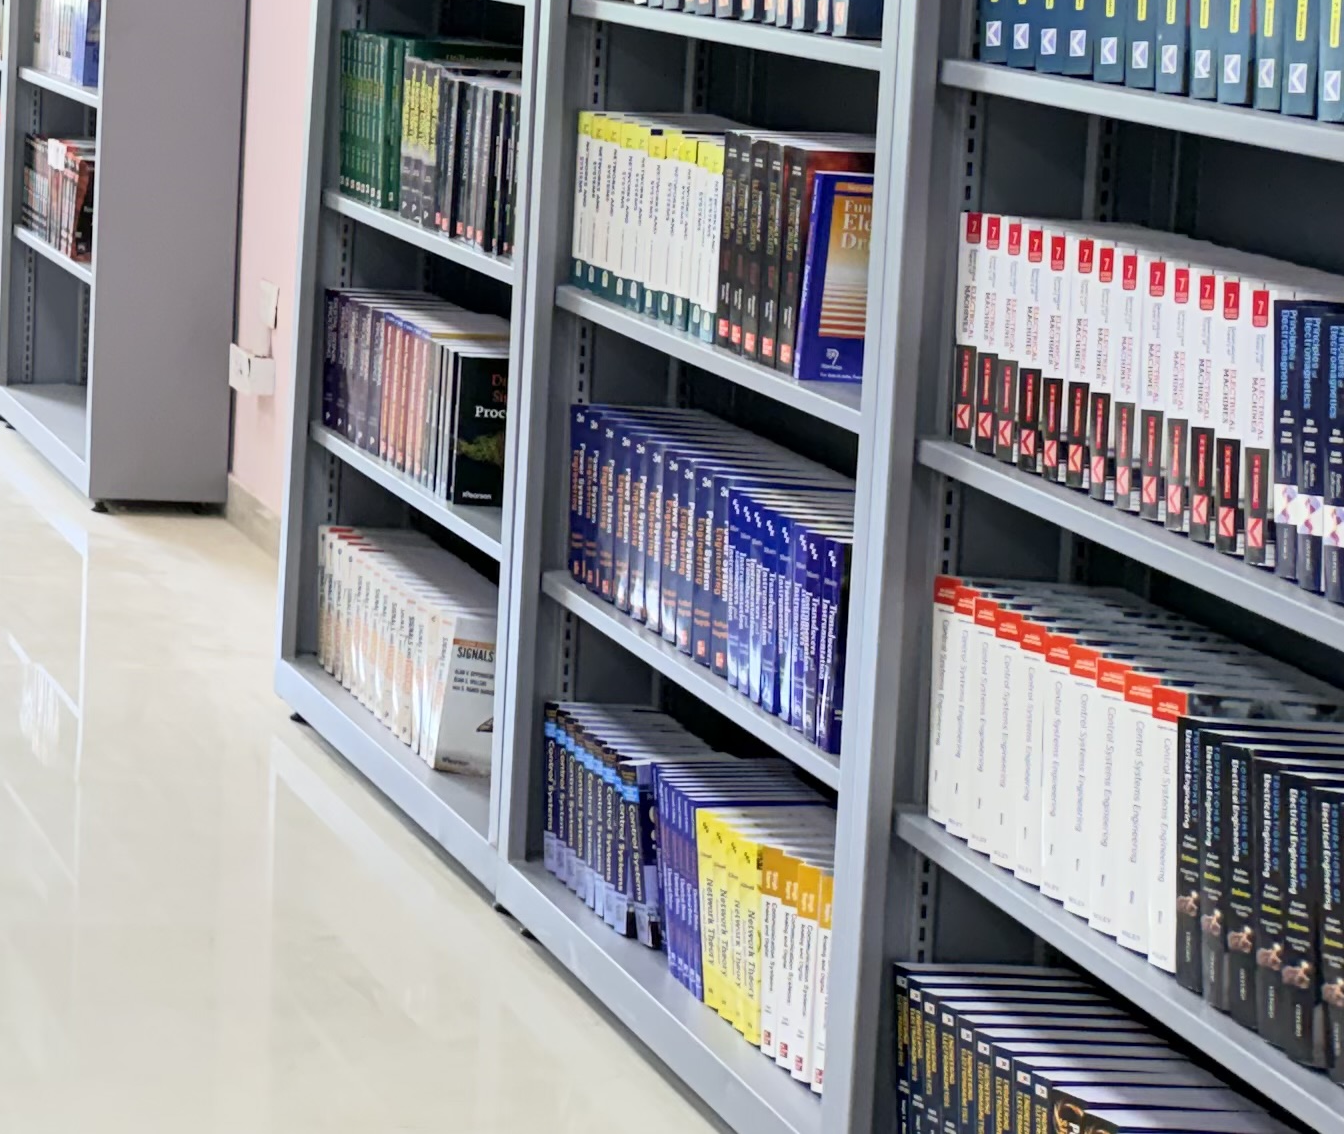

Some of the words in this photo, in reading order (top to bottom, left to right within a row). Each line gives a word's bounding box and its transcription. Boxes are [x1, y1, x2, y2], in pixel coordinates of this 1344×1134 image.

[1025, 306, 1033, 356] MACHINES
[1031, 306, 1040, 362] ELECTRICAL
[1074, 318, 1083, 369] MACHINES
[1079, 319, 1089, 377] ELECTRICAL
[1280, 310, 1289, 401] Electromagnetics
[1197, 359, 1205, 414] MACHINES
[1203, 359, 1212, 421] ELECTRICAL
[1304, 318, 1312, 410] Electromagnetics
[1329, 326, 1338, 419] Electromagnetics
[1221, 369, 1230, 424] MACHINES
[1227, 369, 1237, 432] ELECTRICAL
[1250, 377, 1259, 433] MACHINES
[1256, 378, 1266, 441] ELECTRICAL
[639, 476, 647, 510] Power
[638, 513, 646, 552] System
[678, 508, 687, 575] Engineering
[687, 502, 695, 540] Power
[705, 511, 713, 547] Power
[686, 542, 694, 581] System
[696, 518, 705, 585] Engineering
[768, 573, 776, 629] Transducers
[810, 597, 819, 655] Transducers
[457, 646, 494, 663] SIGNALS
[804, 592, 812, 672] Instrumentation
[819, 599, 829, 680] Instrumentation
[827, 604, 837, 663] Transducers
[939, 654, 947, 690] Systems
[935, 694, 944, 746] Engineering
[1107, 706, 1115, 742] Control
[1135, 721, 1145, 756] Control
[1104, 745, 1114, 786] Systems
[1133, 760, 1143, 801] Systems
[1163, 738, 1172, 774] Control
[1100, 789, 1111, 847] Engineering
[1161, 778, 1171, 819] Systems
[1183, 774, 1191, 828] Engineering
[1205, 790, 1213, 847] Engineering
[1263, 774, 1271, 819] Electrical
[1289, 788, 1298, 834] Electrical
[629, 805, 639, 849] Control
[1130, 805, 1141, 863] Engineering
[1158, 823, 1169, 882] Engineering
[1232, 805, 1240, 862] Engineering
[1262, 820, 1271, 878] Engineering
[1321, 802, 1330, 849] Electrical
[633, 852, 642, 901] Systems
[1289, 836, 1298, 894] Engineering
[1323, 850, 1332, 910] Engineering
[706, 878, 714, 924] Network
[720, 889, 728, 934] Network
[748, 910, 756, 957] Network
